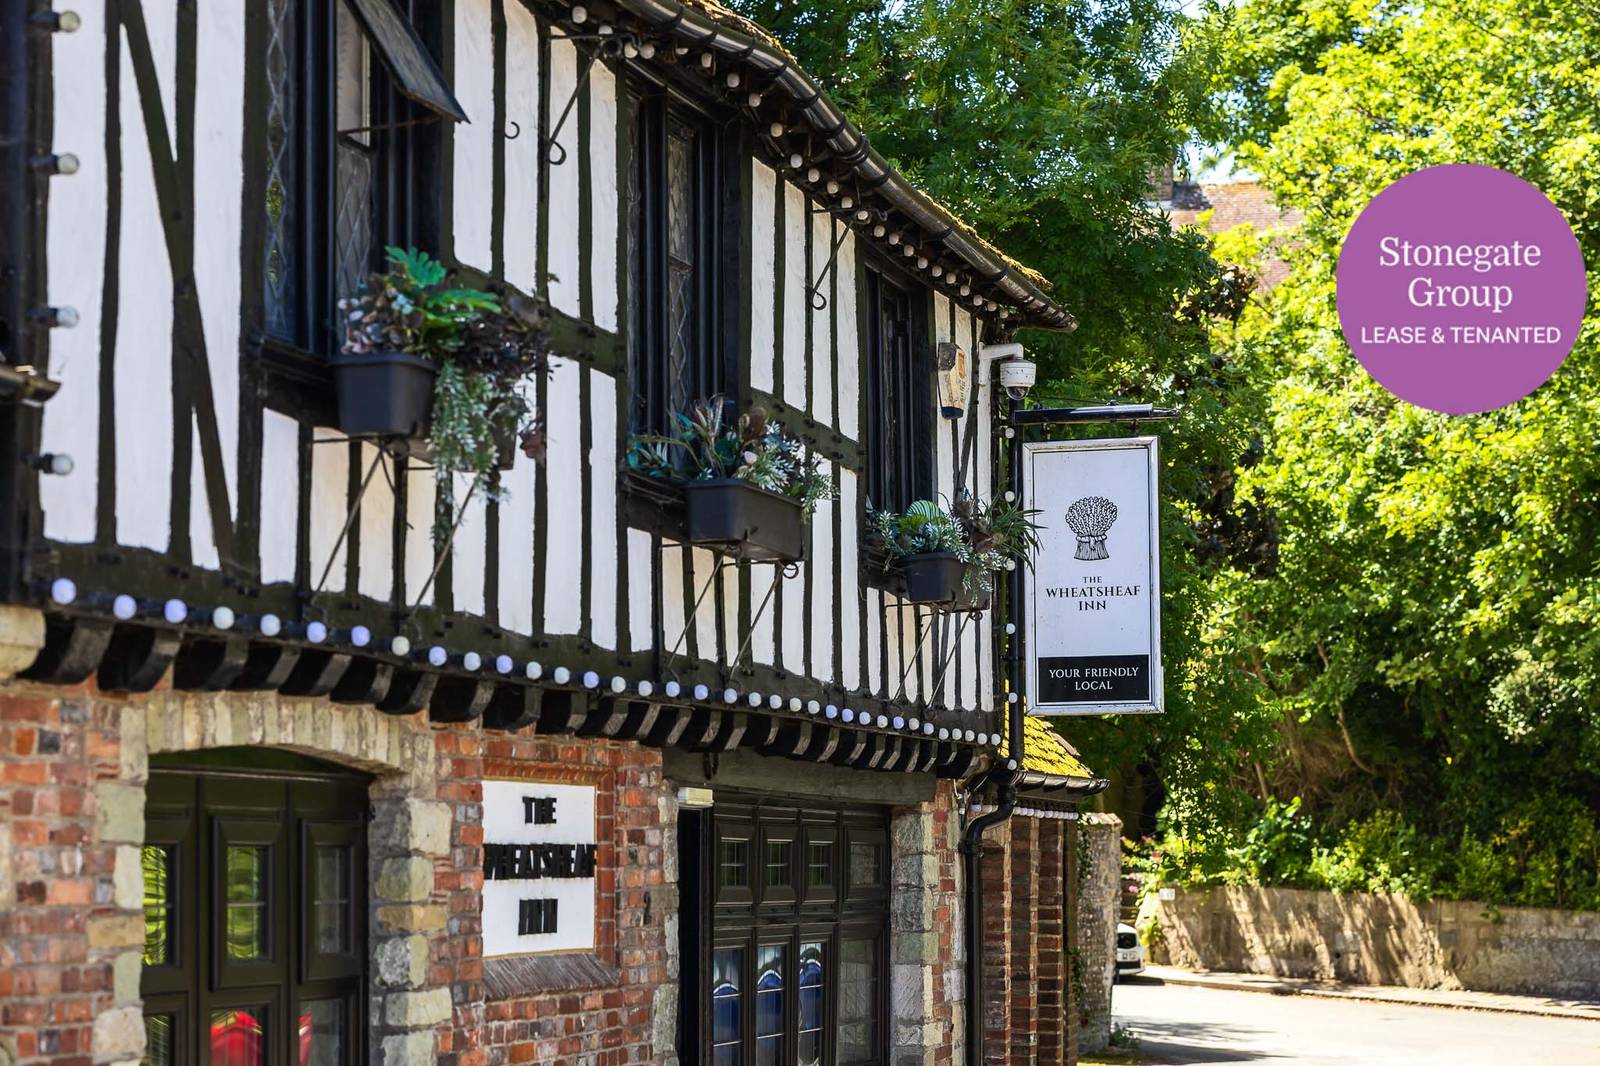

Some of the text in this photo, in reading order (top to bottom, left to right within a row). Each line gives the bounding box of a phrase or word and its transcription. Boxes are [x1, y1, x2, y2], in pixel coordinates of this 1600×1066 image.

[1082, 576, 1103, 584] THE
[1045, 585, 1141, 598] WHEATSHEAF
[1078, 600, 1107, 611] INN
[1049, 666, 1139, 679] YOUR FRIENDLY
[1075, 680, 1113, 691] LOCAL
[522, 796, 557, 825] THE
